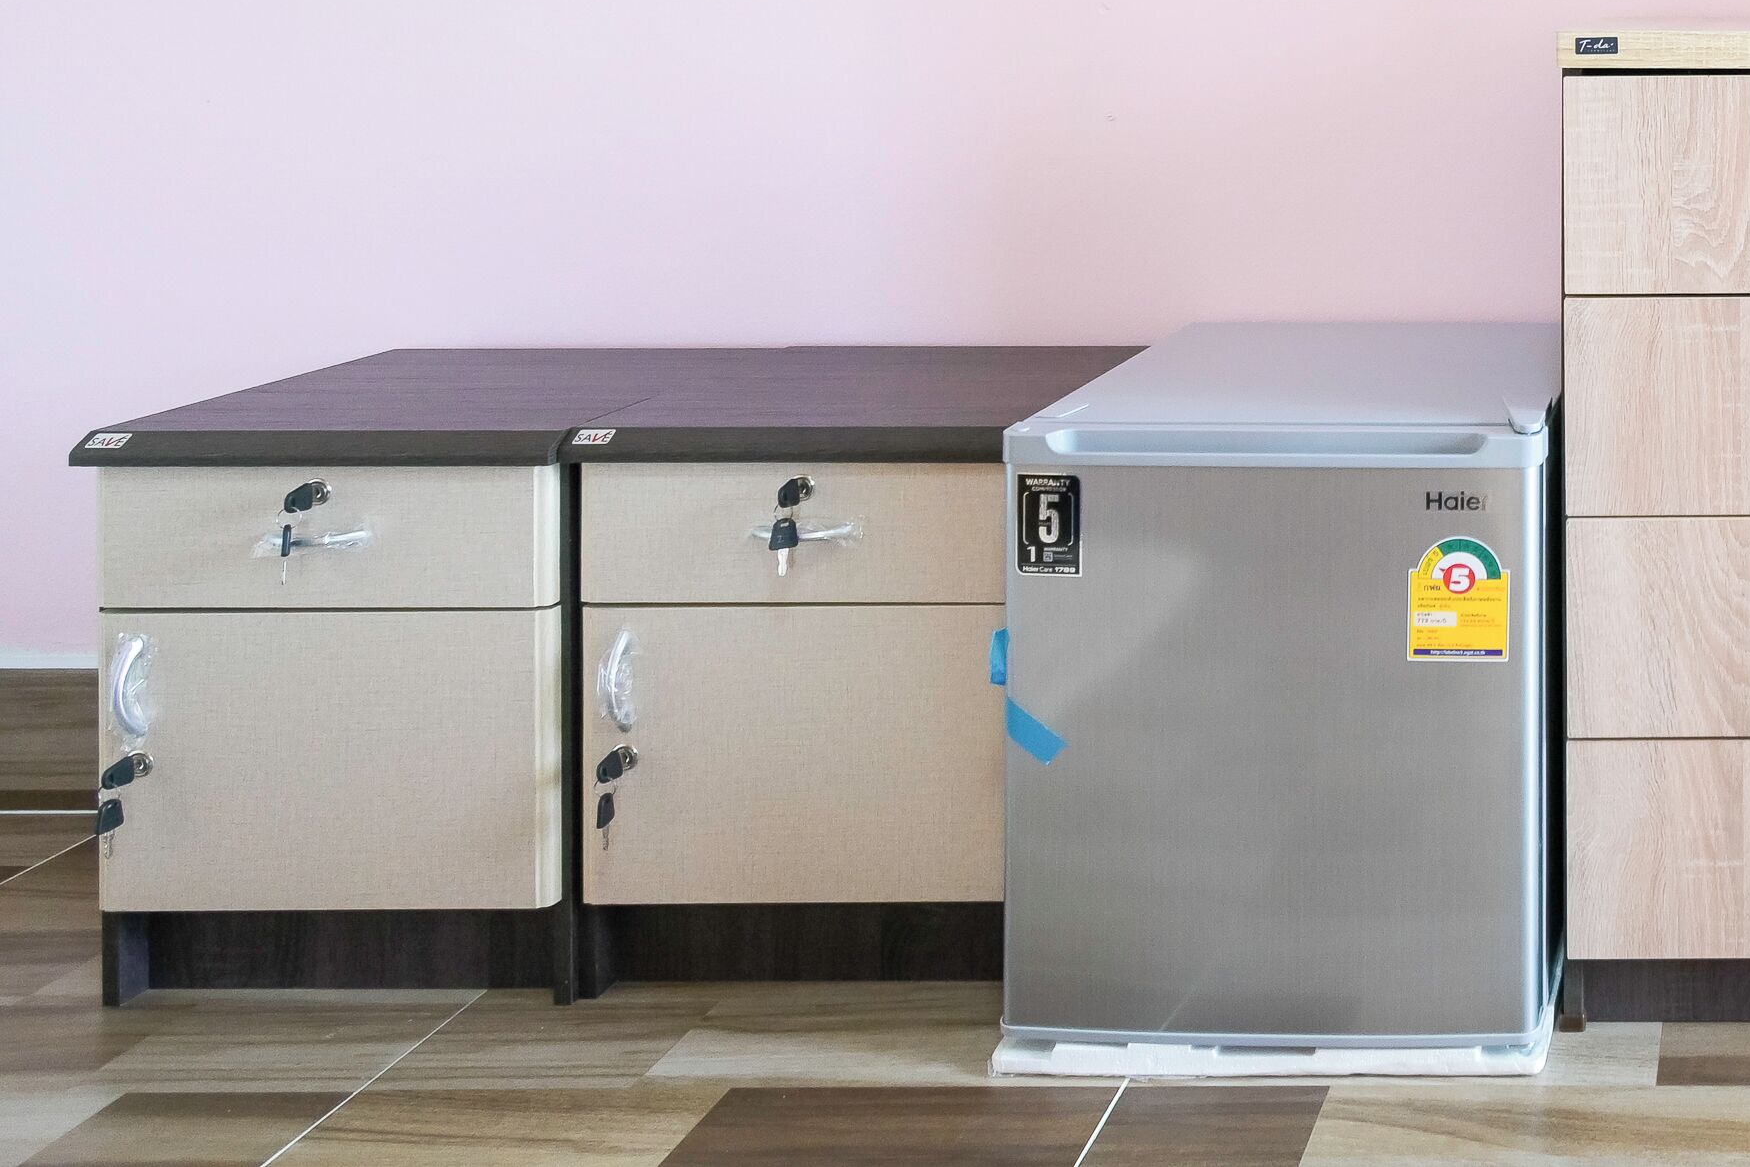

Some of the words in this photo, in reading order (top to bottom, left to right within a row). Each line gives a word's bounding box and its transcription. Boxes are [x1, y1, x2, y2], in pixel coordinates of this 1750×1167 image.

[87, 434, 130, 447] SAVE
[574, 430, 613, 443] SAVE
[1425, 490, 1488, 511] Haier
[1038, 493, 1060, 544] 5
[1026, 546, 1036, 563] 1
[1449, 566, 1471, 593] 5
